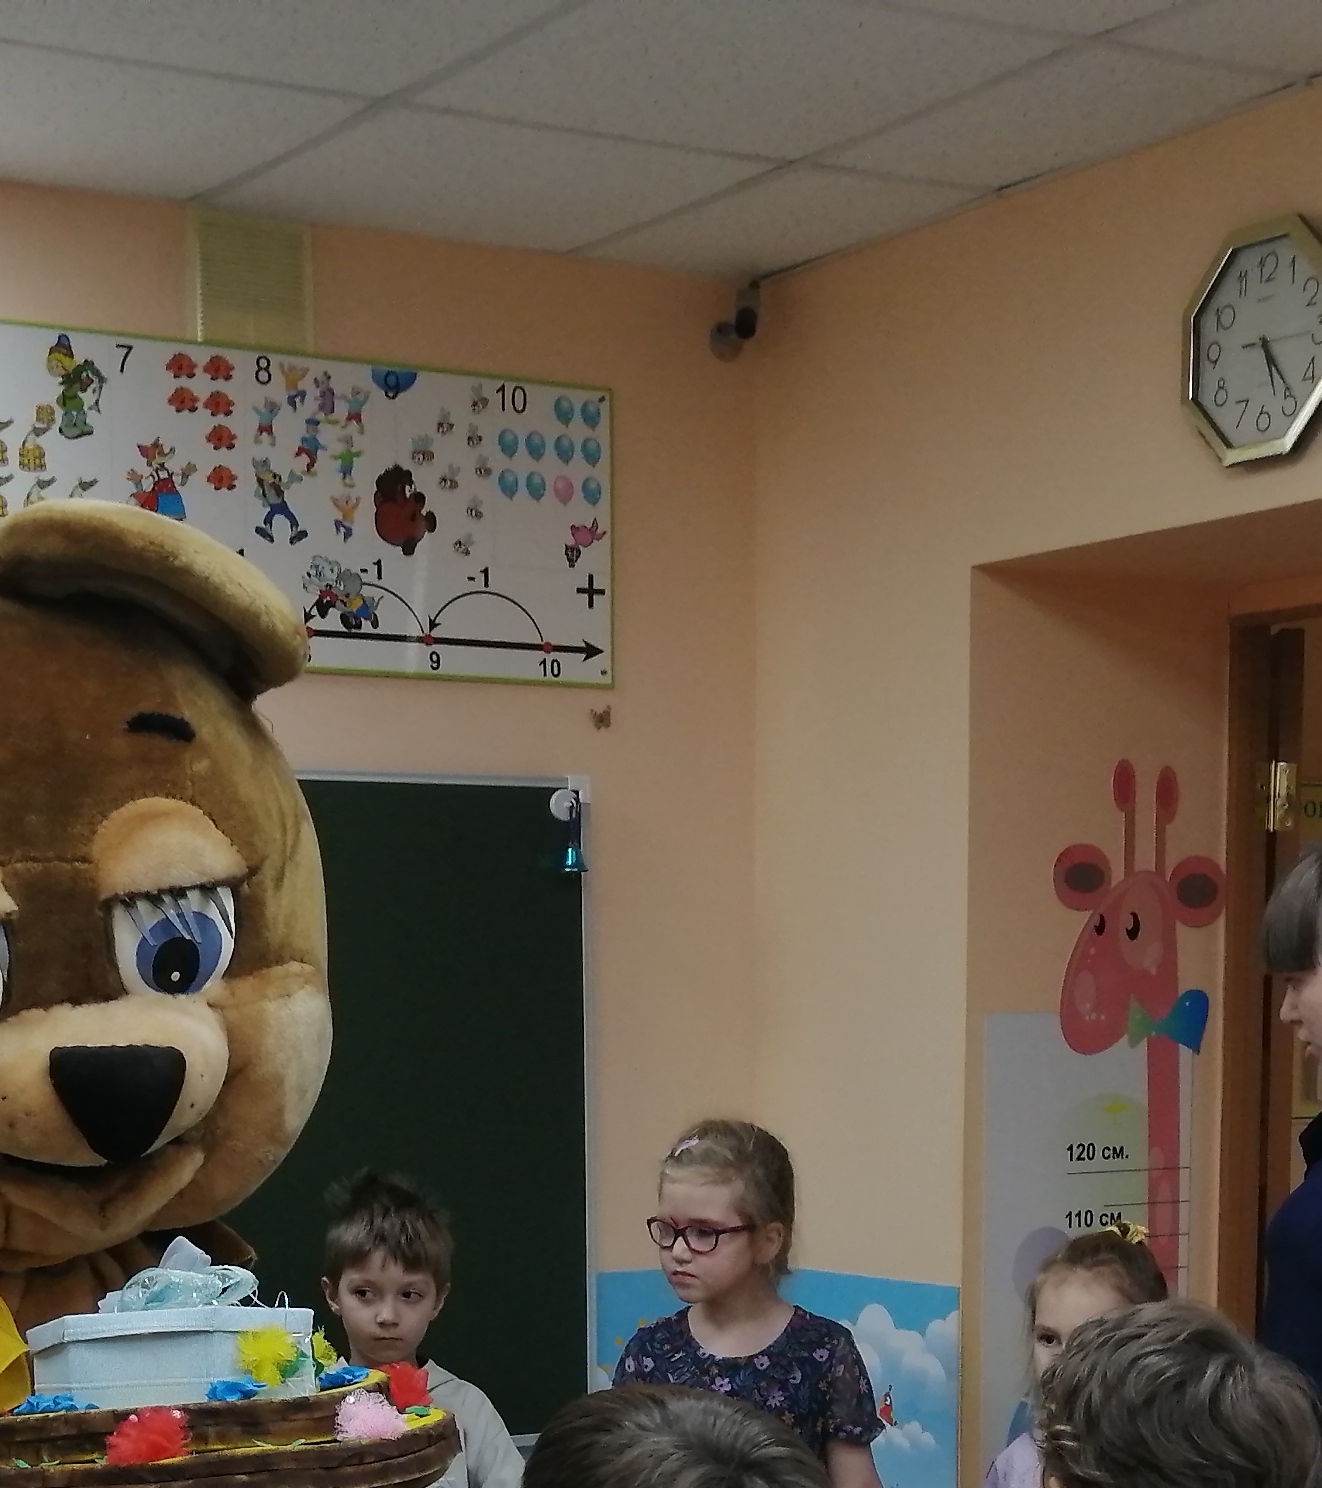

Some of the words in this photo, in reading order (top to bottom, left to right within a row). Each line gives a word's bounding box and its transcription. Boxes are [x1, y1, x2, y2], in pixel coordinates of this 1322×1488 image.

[1257, 251, 1279, 284] 12
[1289, 255, 1297, 284] 1
[1237, 269, 1248, 297] 11
[1302, 277, 1319, 307] 2
[1215, 304, 1236, 332] 10
[1207, 341, 1221, 369] 9
[115, 343, 134, 374] 7
[254, 355, 272, 387] 8
[382, 368, 400, 400] 9
[495, 383, 527, 414] 10
[1302, 357, 1315, 383] 4
[1213, 378, 1228, 407] 8
[1281, 387, 1297, 416] 5
[1235, 399, 1250, 429] 7
[1255, 405, 1271, 432] 6
[429, 651, 441, 671] 9
[539, 657, 562, 679] 10
[1066, 1142, 1096, 1162] 120
[1065, 1209, 1094, 1228] 110
